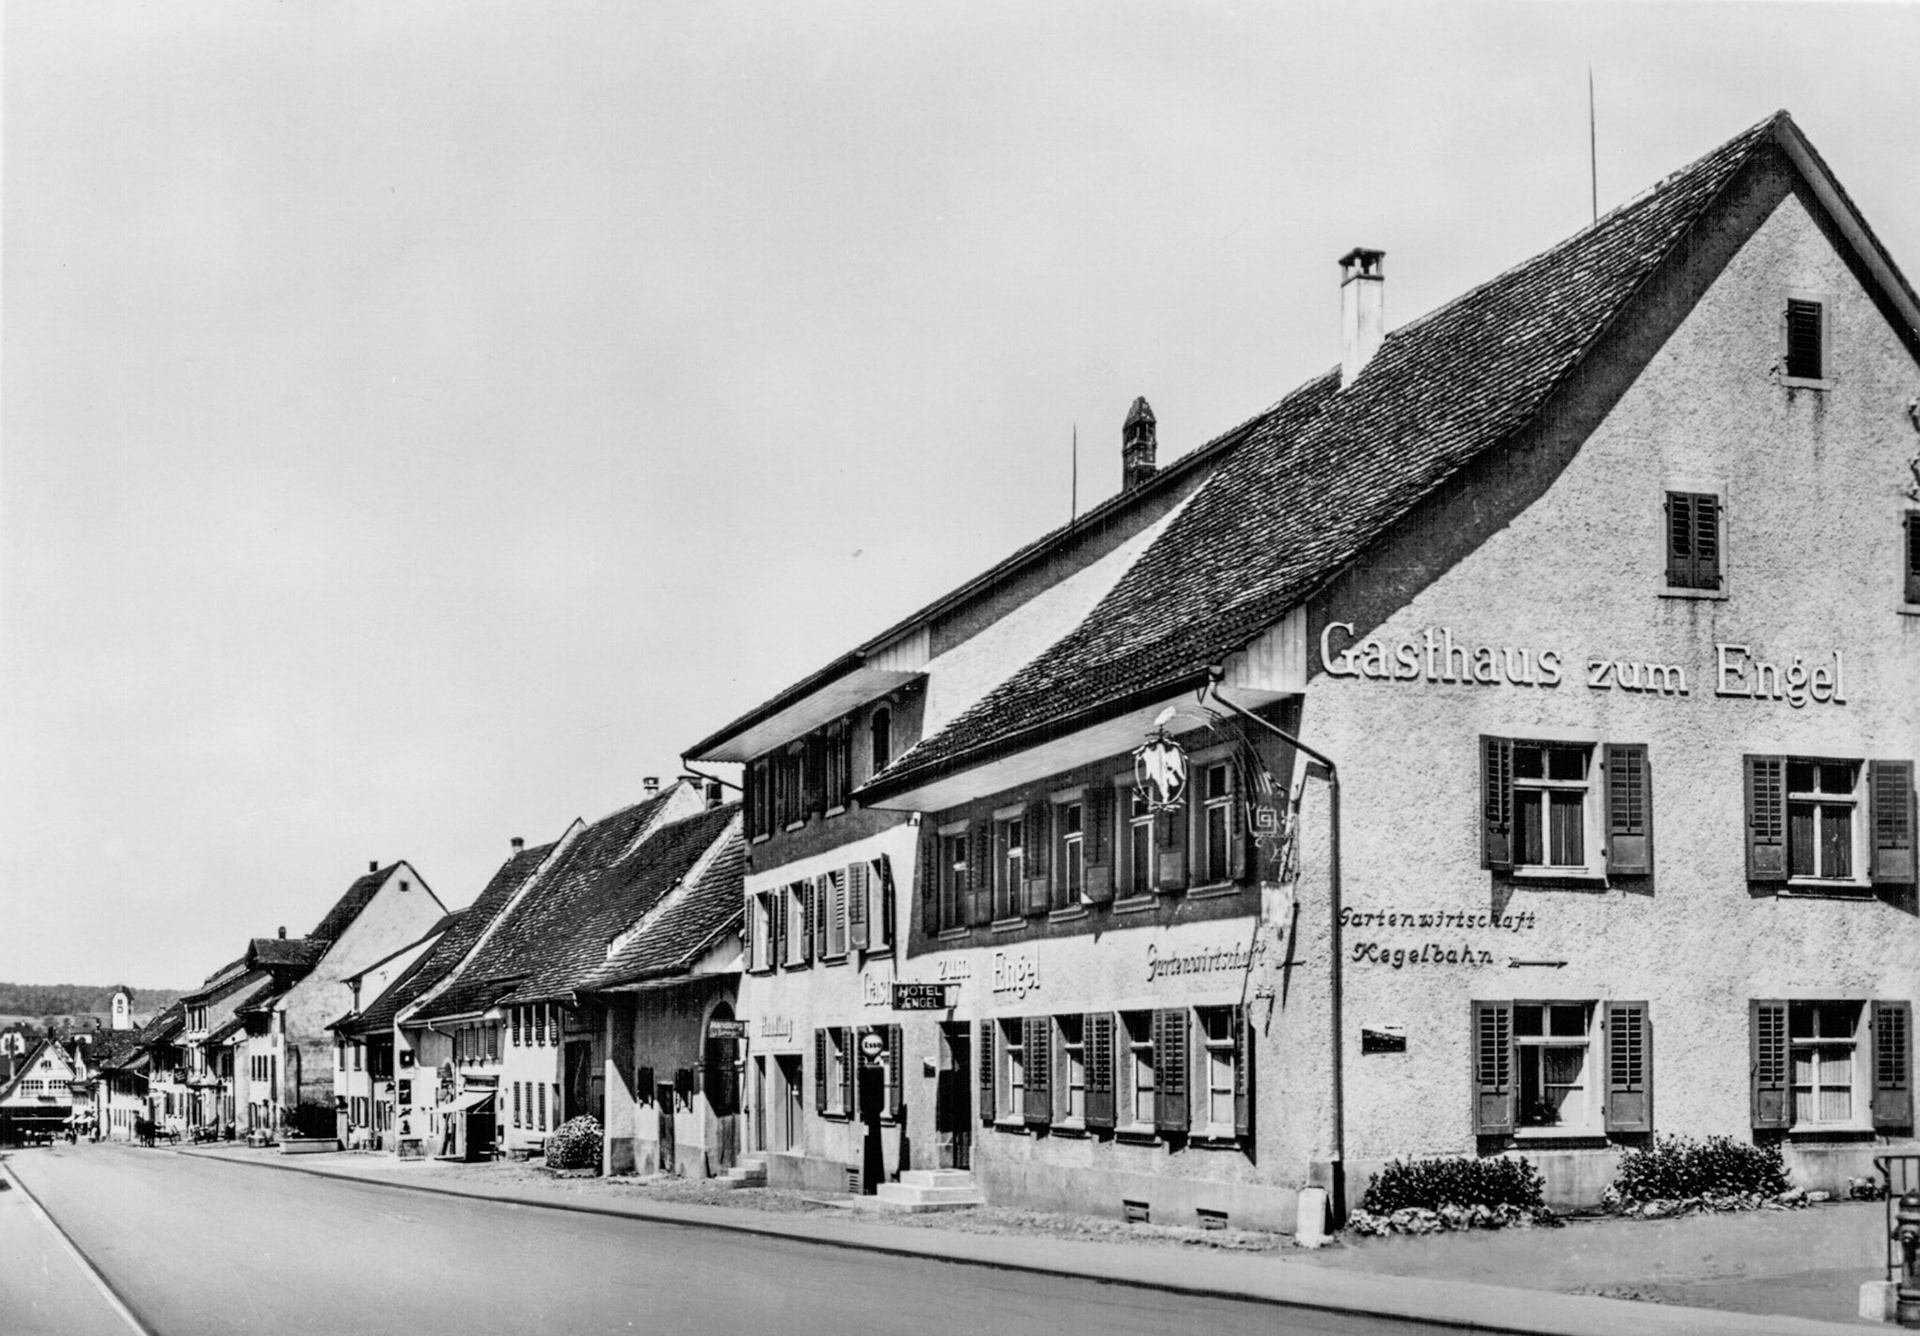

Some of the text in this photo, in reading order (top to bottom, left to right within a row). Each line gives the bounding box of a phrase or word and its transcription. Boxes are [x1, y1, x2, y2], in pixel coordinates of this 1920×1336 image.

[1320, 620, 1848, 708] Gasthaus zum Engel
[1338, 906, 1536, 933] Gartenwirtschaft
[1147, 939, 1267, 983] Gartenwirtschaft
[1351, 942, 1494, 970] Kegelbahn
[938, 958, 972, 981] zum
[992, 945, 1041, 1000] Engel
[898, 985, 943, 997] HOTEL
[903, 997, 940, 1009] ENGEL
[864, 1041, 882, 1050] Esso
